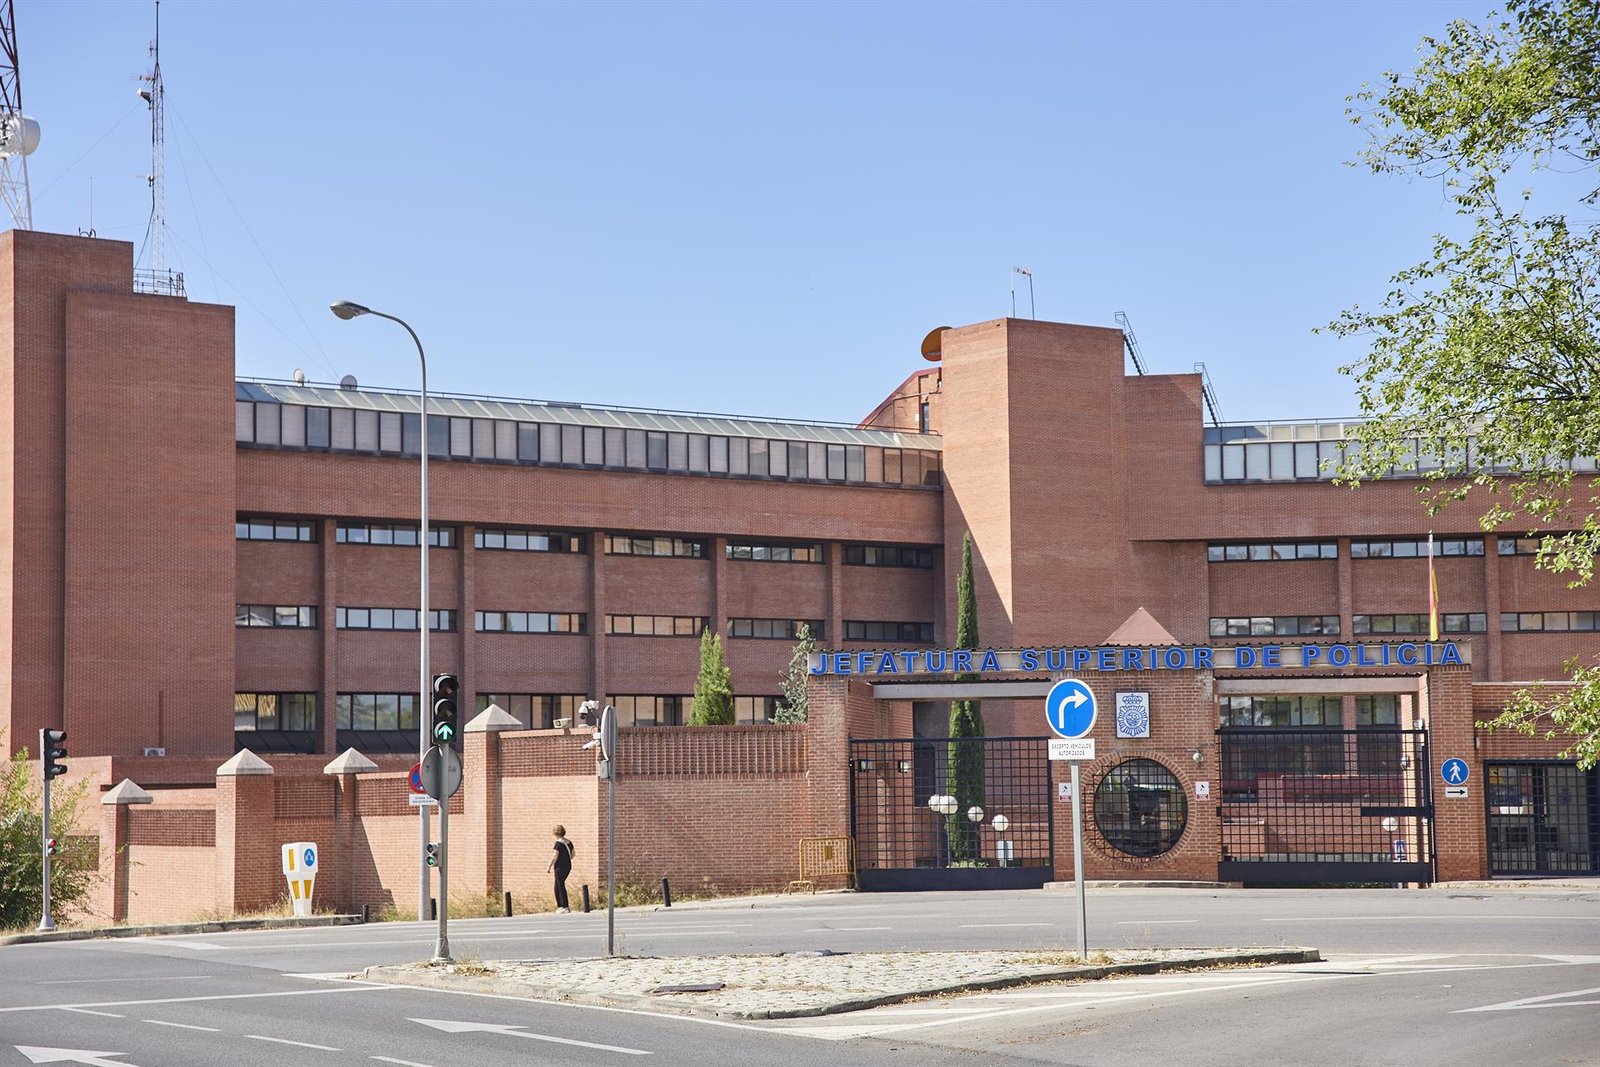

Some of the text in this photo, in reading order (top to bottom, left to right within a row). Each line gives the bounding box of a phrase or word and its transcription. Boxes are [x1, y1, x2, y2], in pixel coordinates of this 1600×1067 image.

[811, 643, 1464, 676] JEFATURA SUPERIOR DE POLICIA
